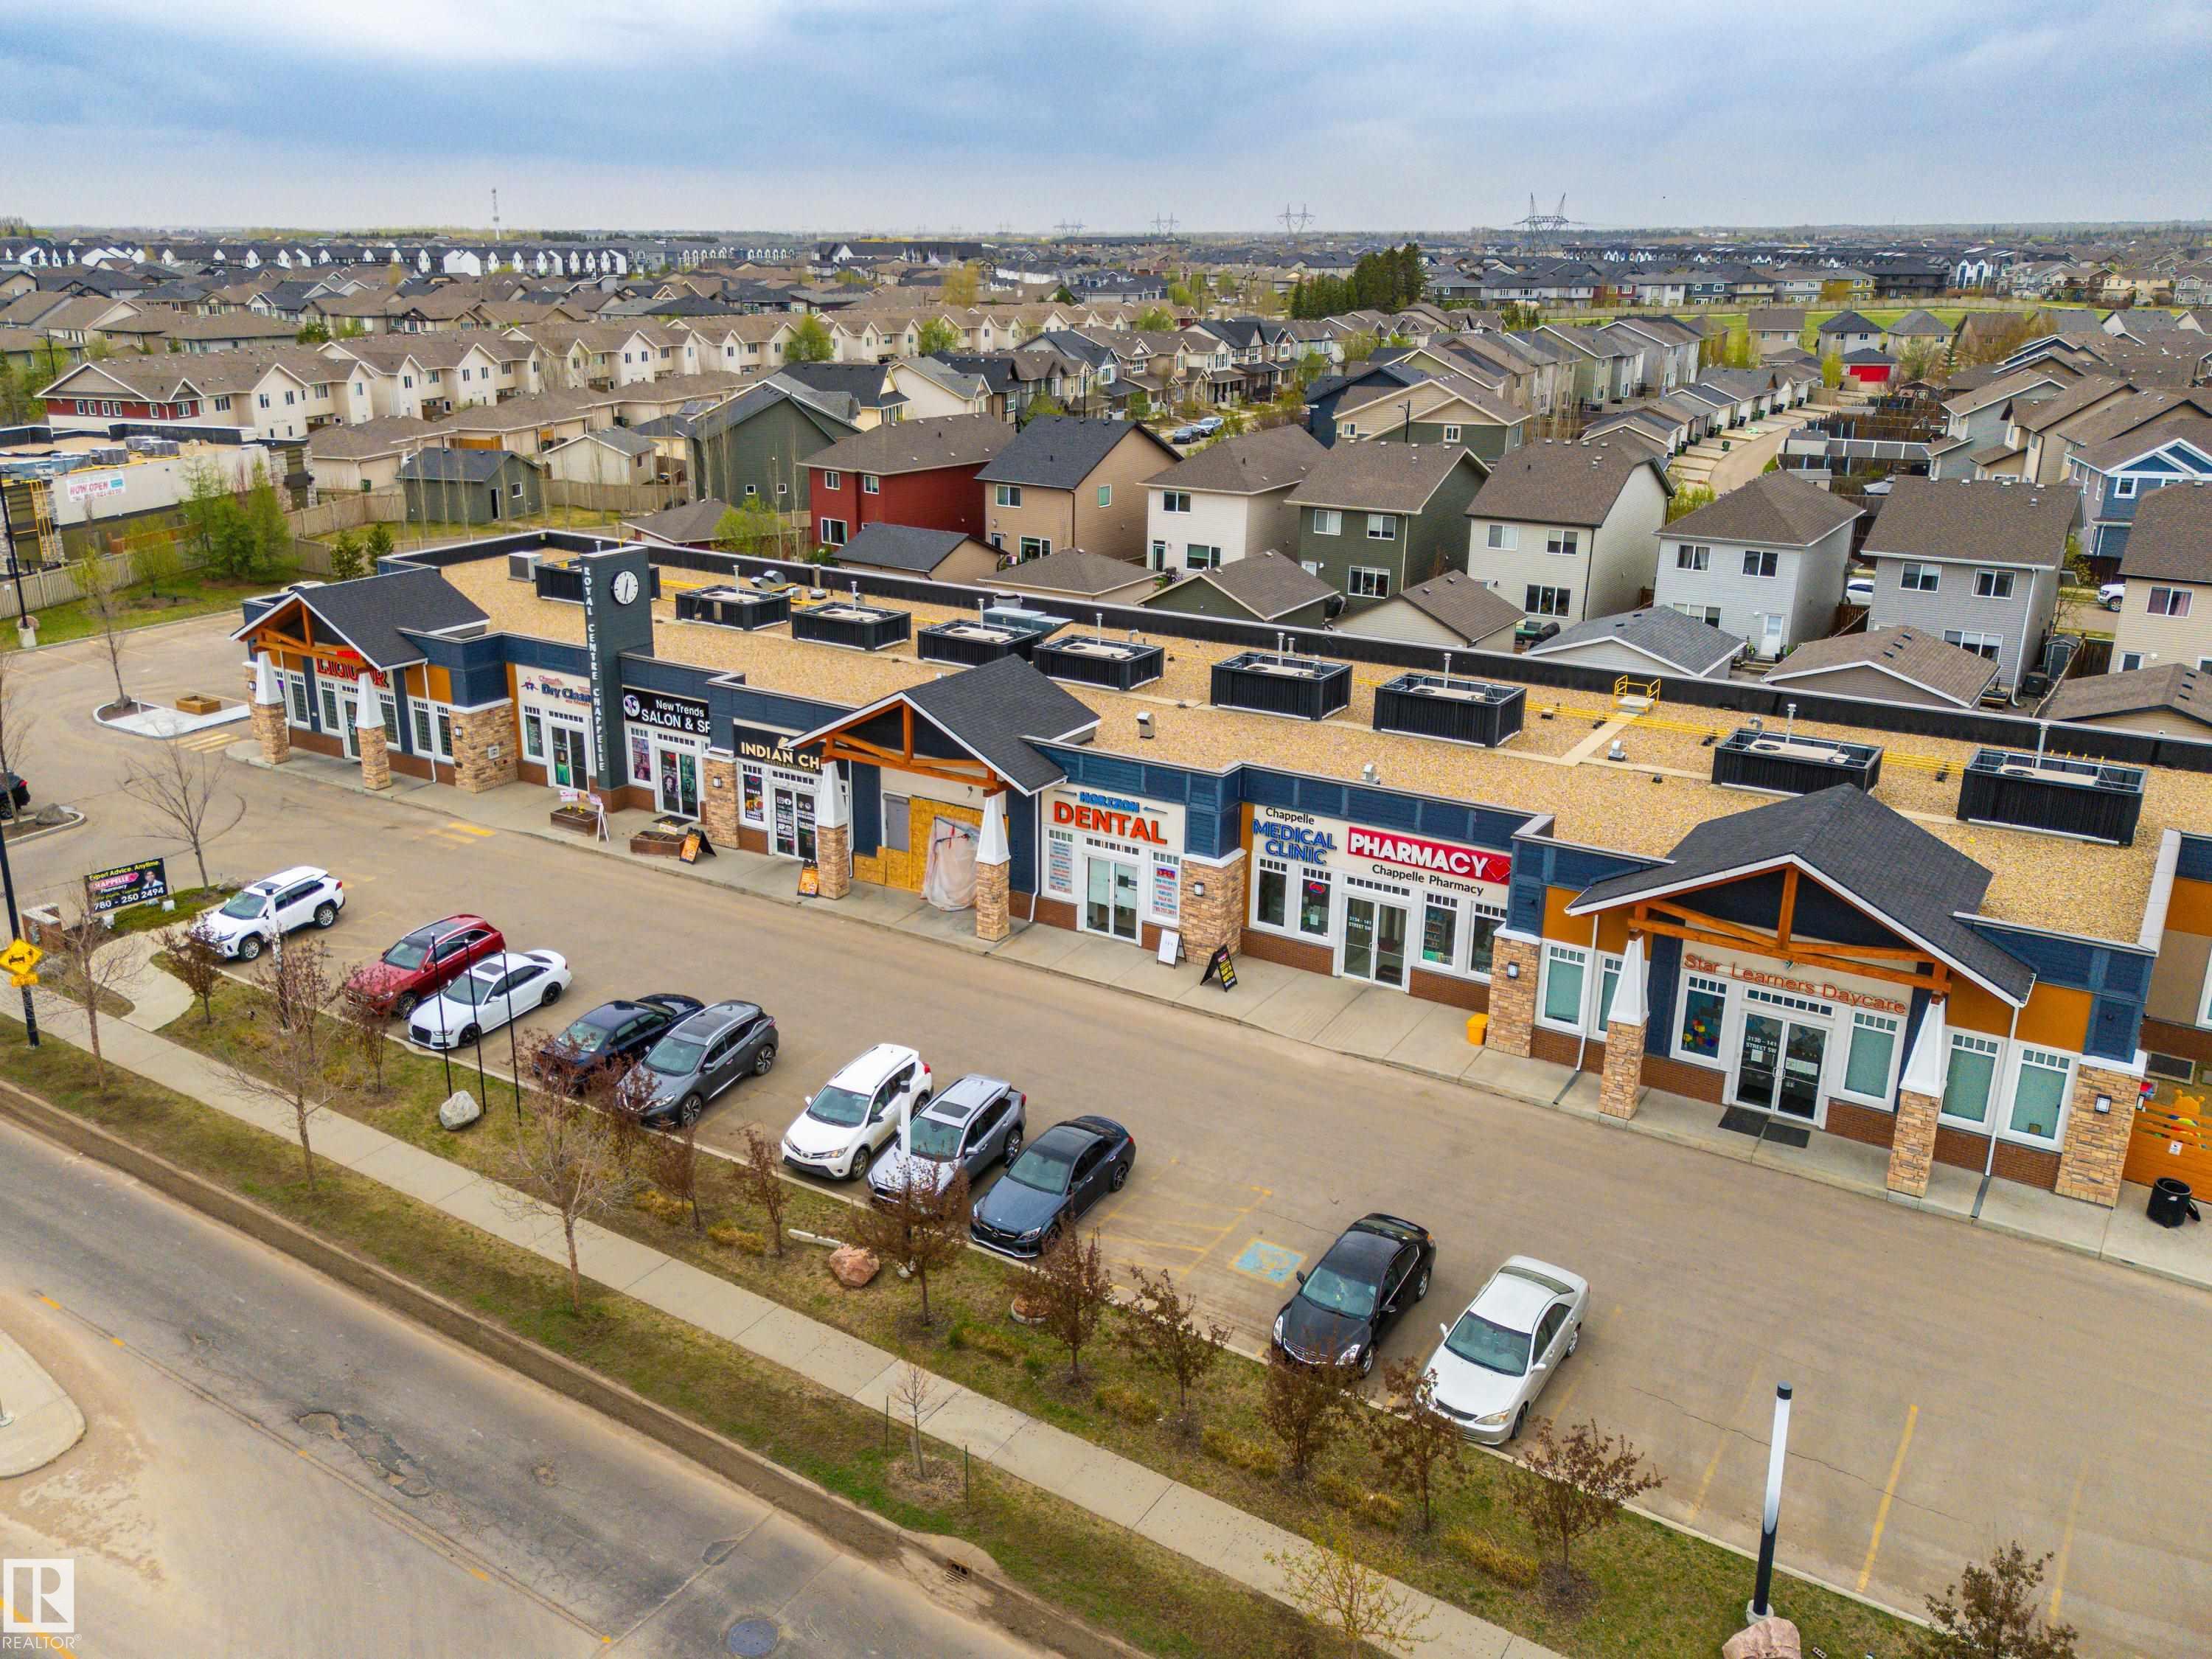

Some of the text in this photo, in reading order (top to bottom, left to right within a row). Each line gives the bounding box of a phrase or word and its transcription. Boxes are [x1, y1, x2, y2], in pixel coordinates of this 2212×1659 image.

[316, 658, 389, 689] LIQUR
[583, 566, 605, 771] ROYAL CENTRE CHAPPELLE
[541, 683, 560, 698] Dry
[641, 709, 681, 728] SALON
[685, 717, 693, 731] &
[655, 699, 704, 717] New Trends
[740, 742, 824, 771] INDIAN CH
[1079, 792, 1140, 813] HORIZON
[1265, 807, 1315, 825] Chappelle
[1054, 801, 1168, 845] DENTAL
[1252, 818, 1338, 850] MEDICAL
[1265, 839, 1327, 866] CLINIC
[1350, 832, 1489, 877] PHARMACY
[88, 872, 108, 880] Expert
[1372, 864, 1484, 897] Chappelle Pharmacy
[94, 900, 111, 911] 780
[122, 893, 139, 904] 250
[141, 887, 164, 899] 2494
[1683, 954, 1907, 1015] Star Learners Daycare
[1745, 1042, 1767, 1051] STREET
